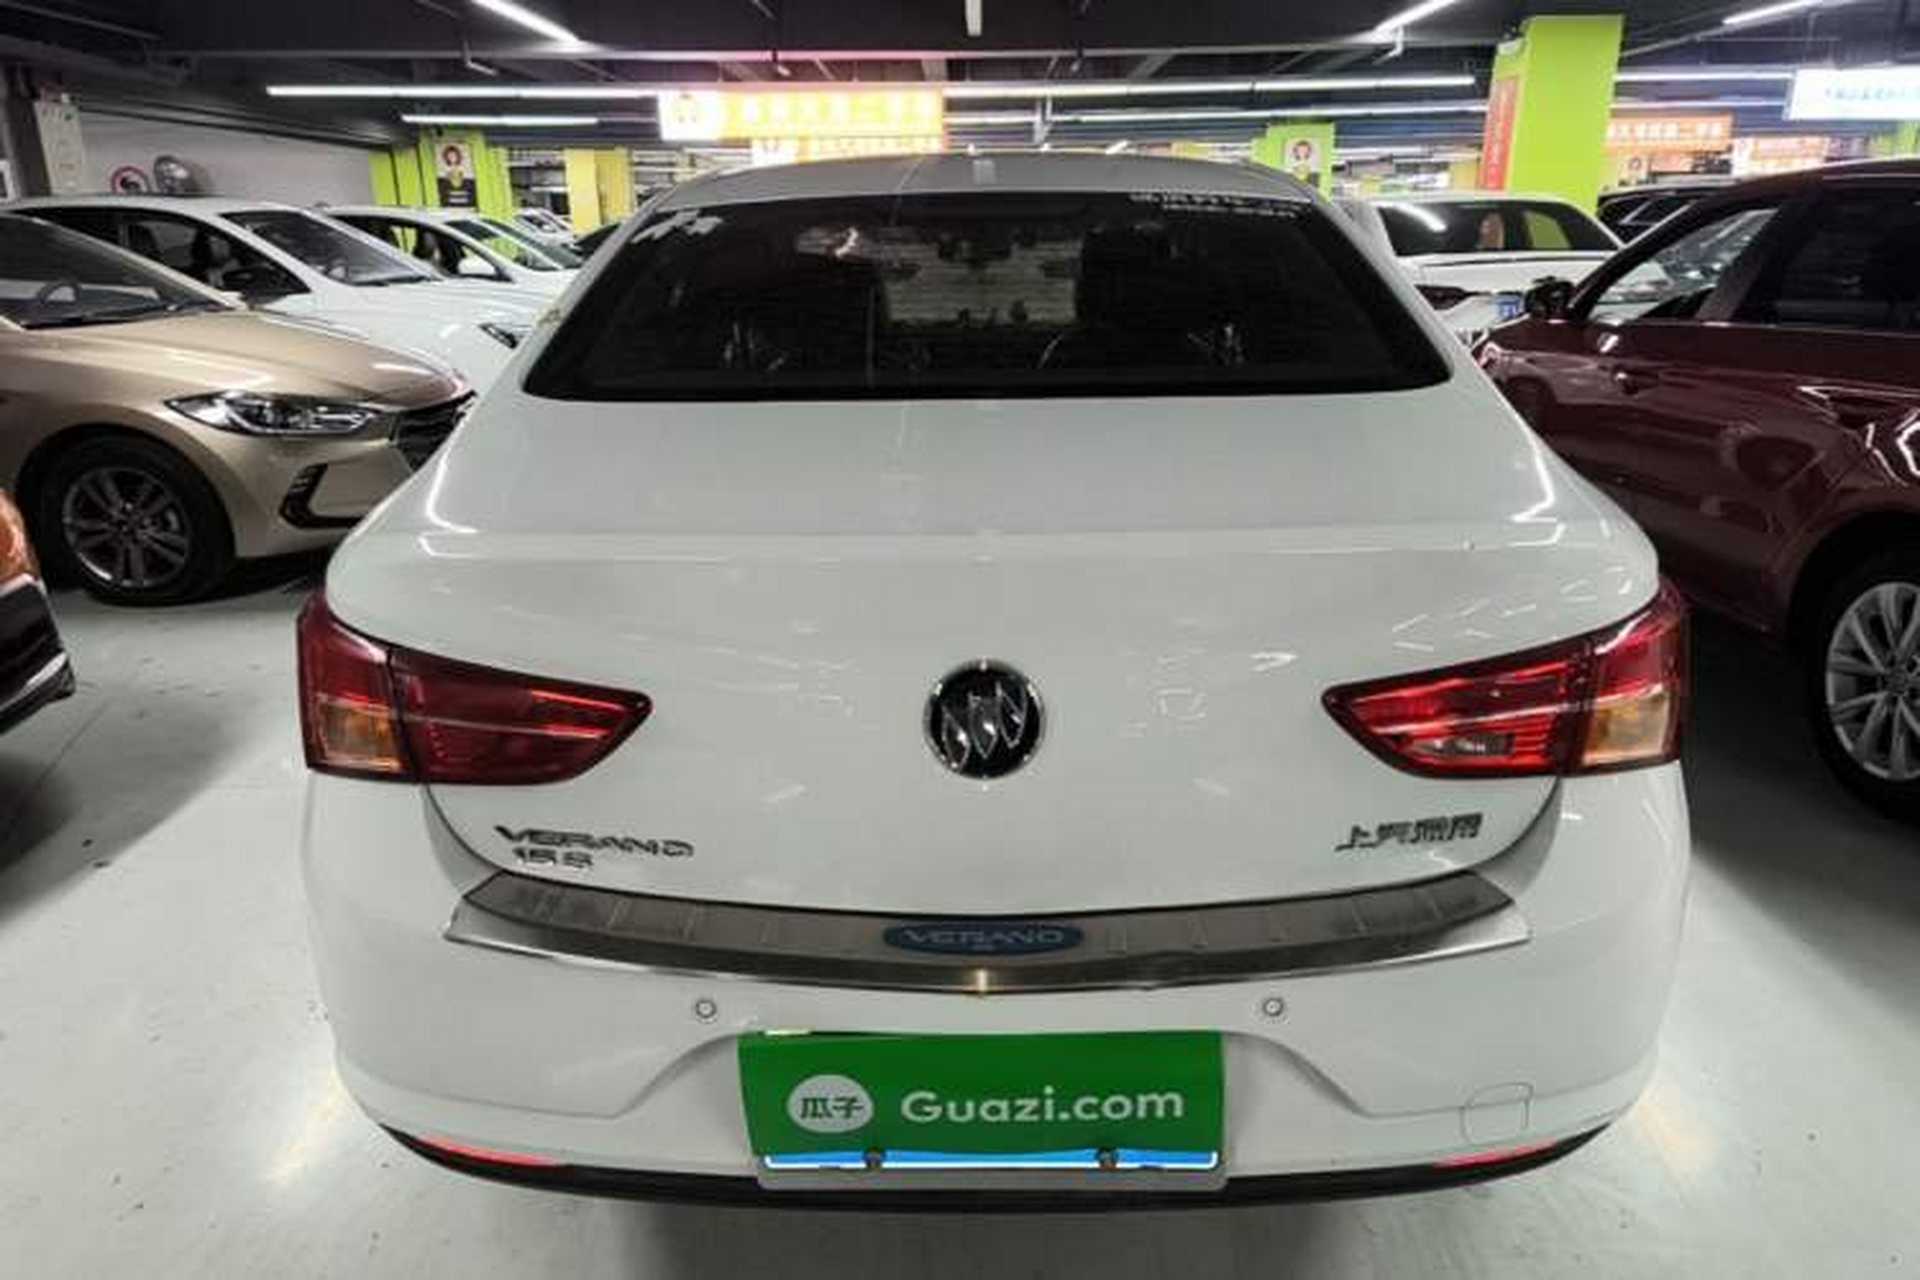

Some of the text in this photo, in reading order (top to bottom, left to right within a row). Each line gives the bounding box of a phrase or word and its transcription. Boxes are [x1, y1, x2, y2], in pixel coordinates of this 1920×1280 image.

[494, 824, 694, 857] VERANO
[800, 1096, 863, 1120] 瓜子
[901, 1085, 1185, 1123] Guazi.com
